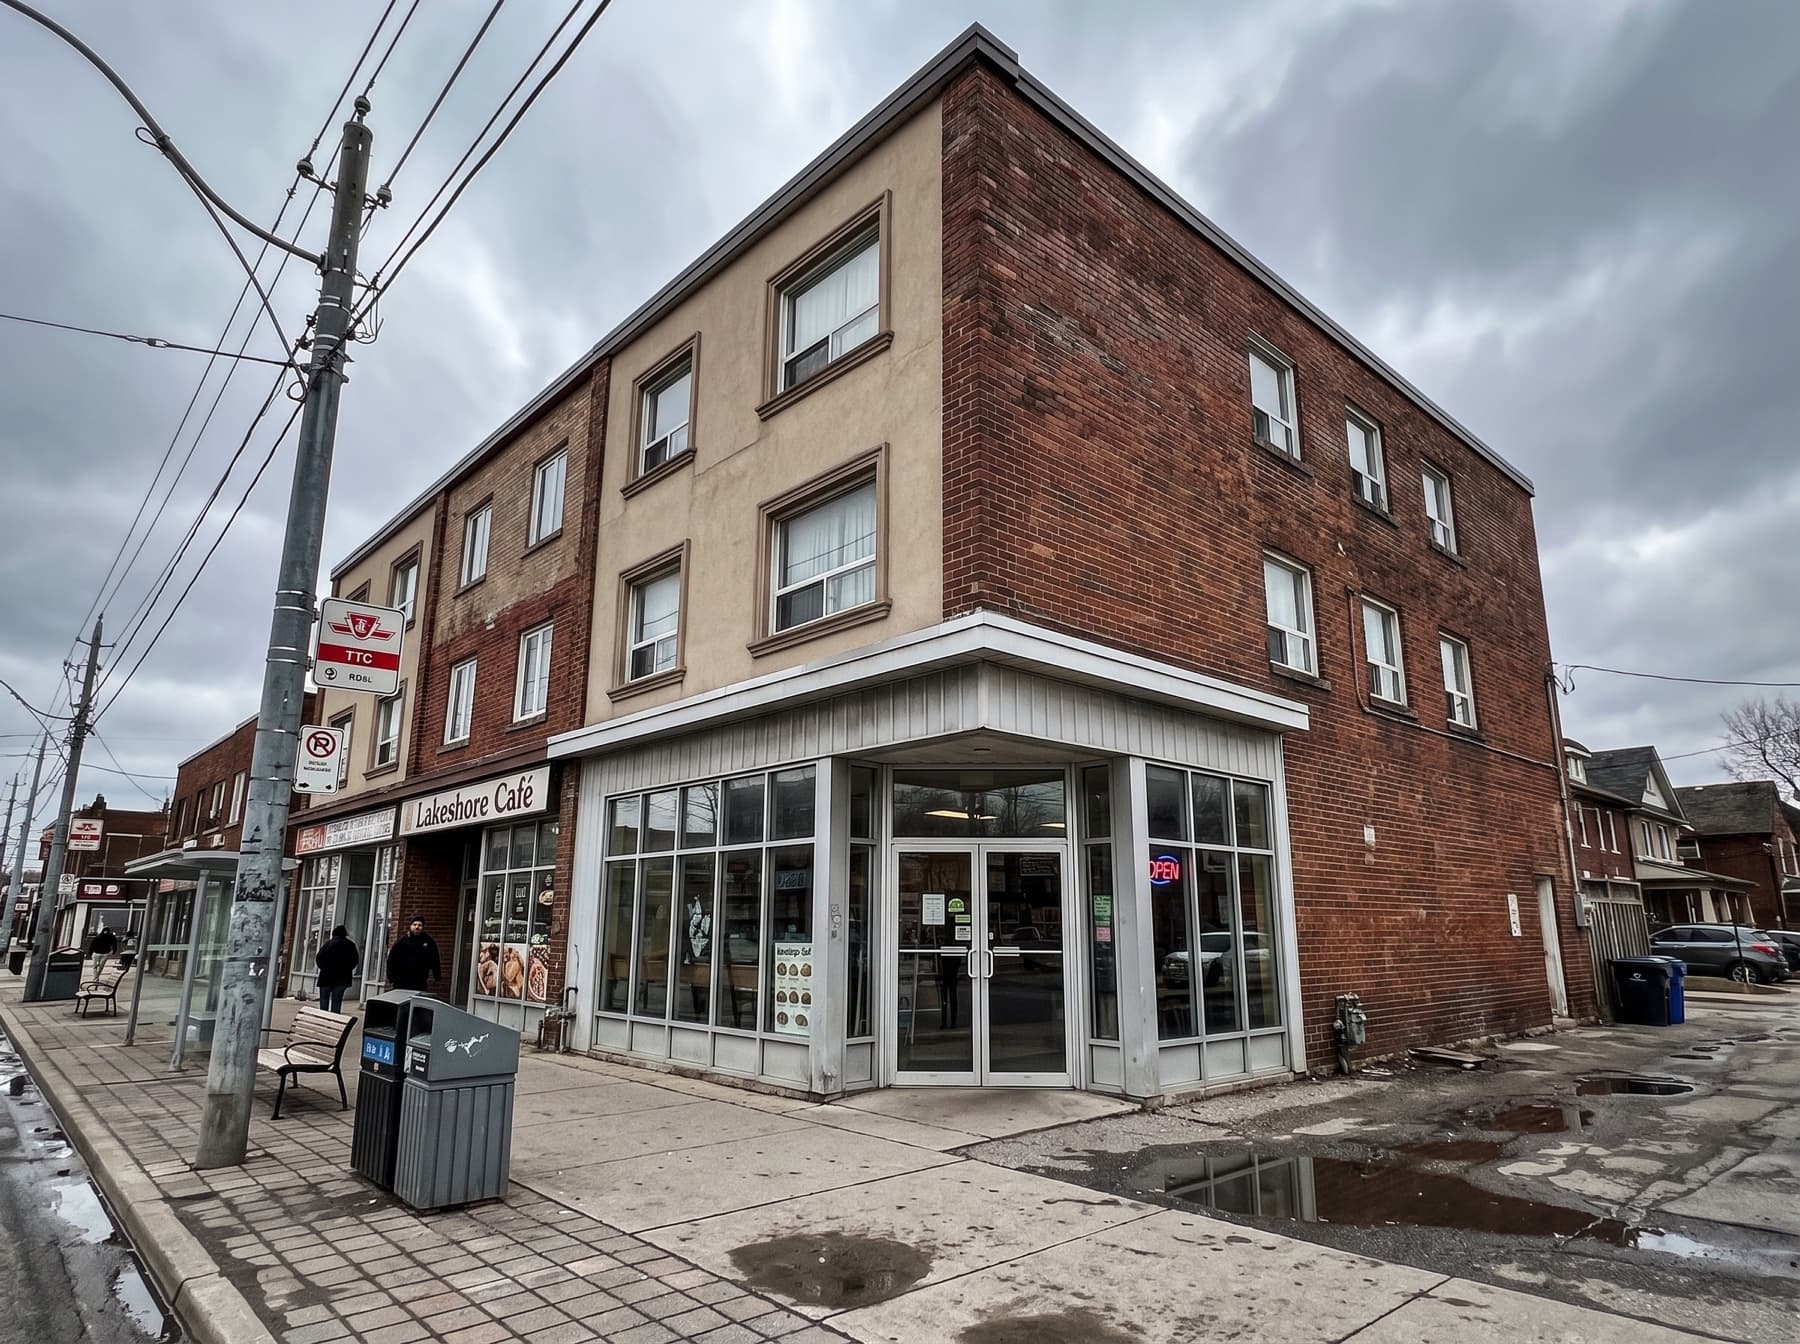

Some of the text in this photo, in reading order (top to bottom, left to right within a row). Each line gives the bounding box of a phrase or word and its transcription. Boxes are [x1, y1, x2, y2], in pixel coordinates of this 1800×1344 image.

[345, 650, 373, 664] TTC
[416, 792, 489, 828] Lakeshore
[494, 775, 534, 814] Café
[1148, 860, 1180, 880] OPEN
